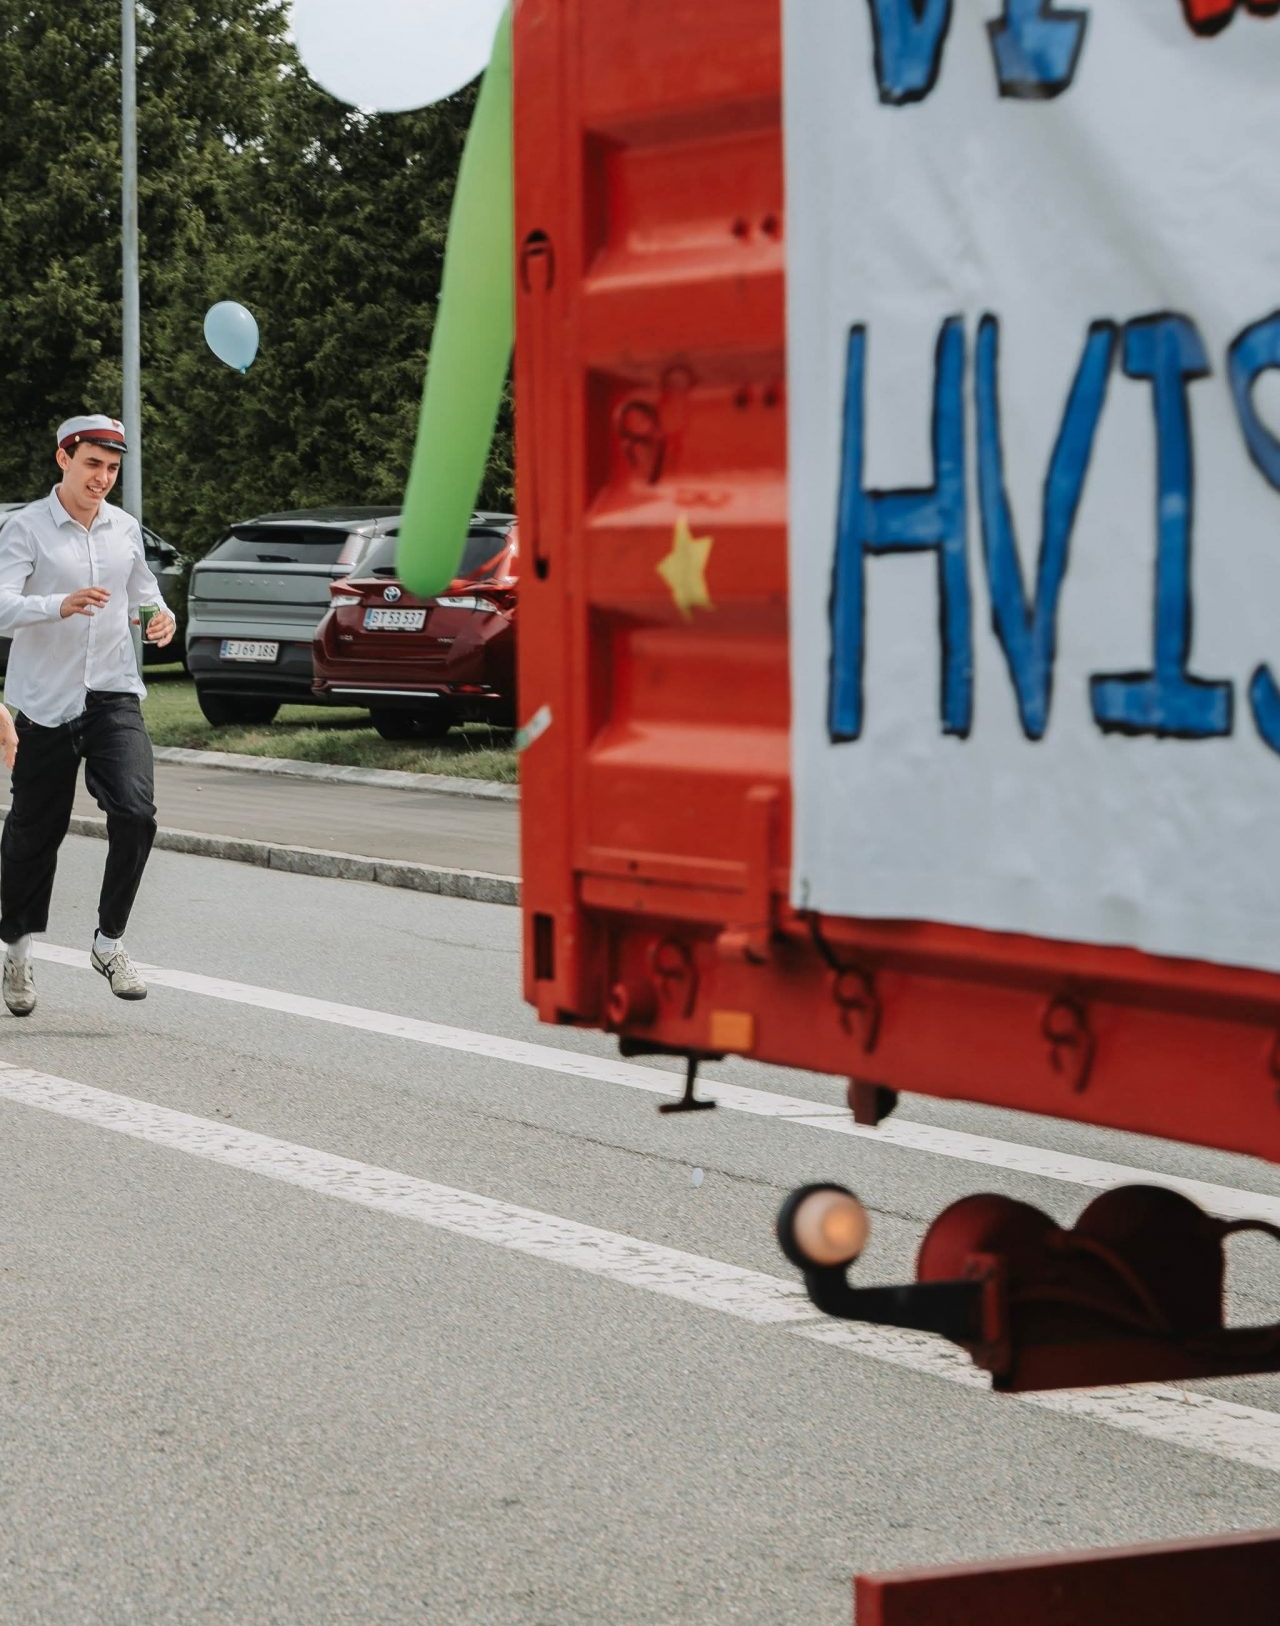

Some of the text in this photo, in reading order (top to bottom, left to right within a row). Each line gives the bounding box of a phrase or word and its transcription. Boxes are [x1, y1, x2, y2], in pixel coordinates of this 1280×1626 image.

[387, 611, 401, 625] 53
[402, 611, 423, 625] 537
[242, 644, 256, 656] 69
